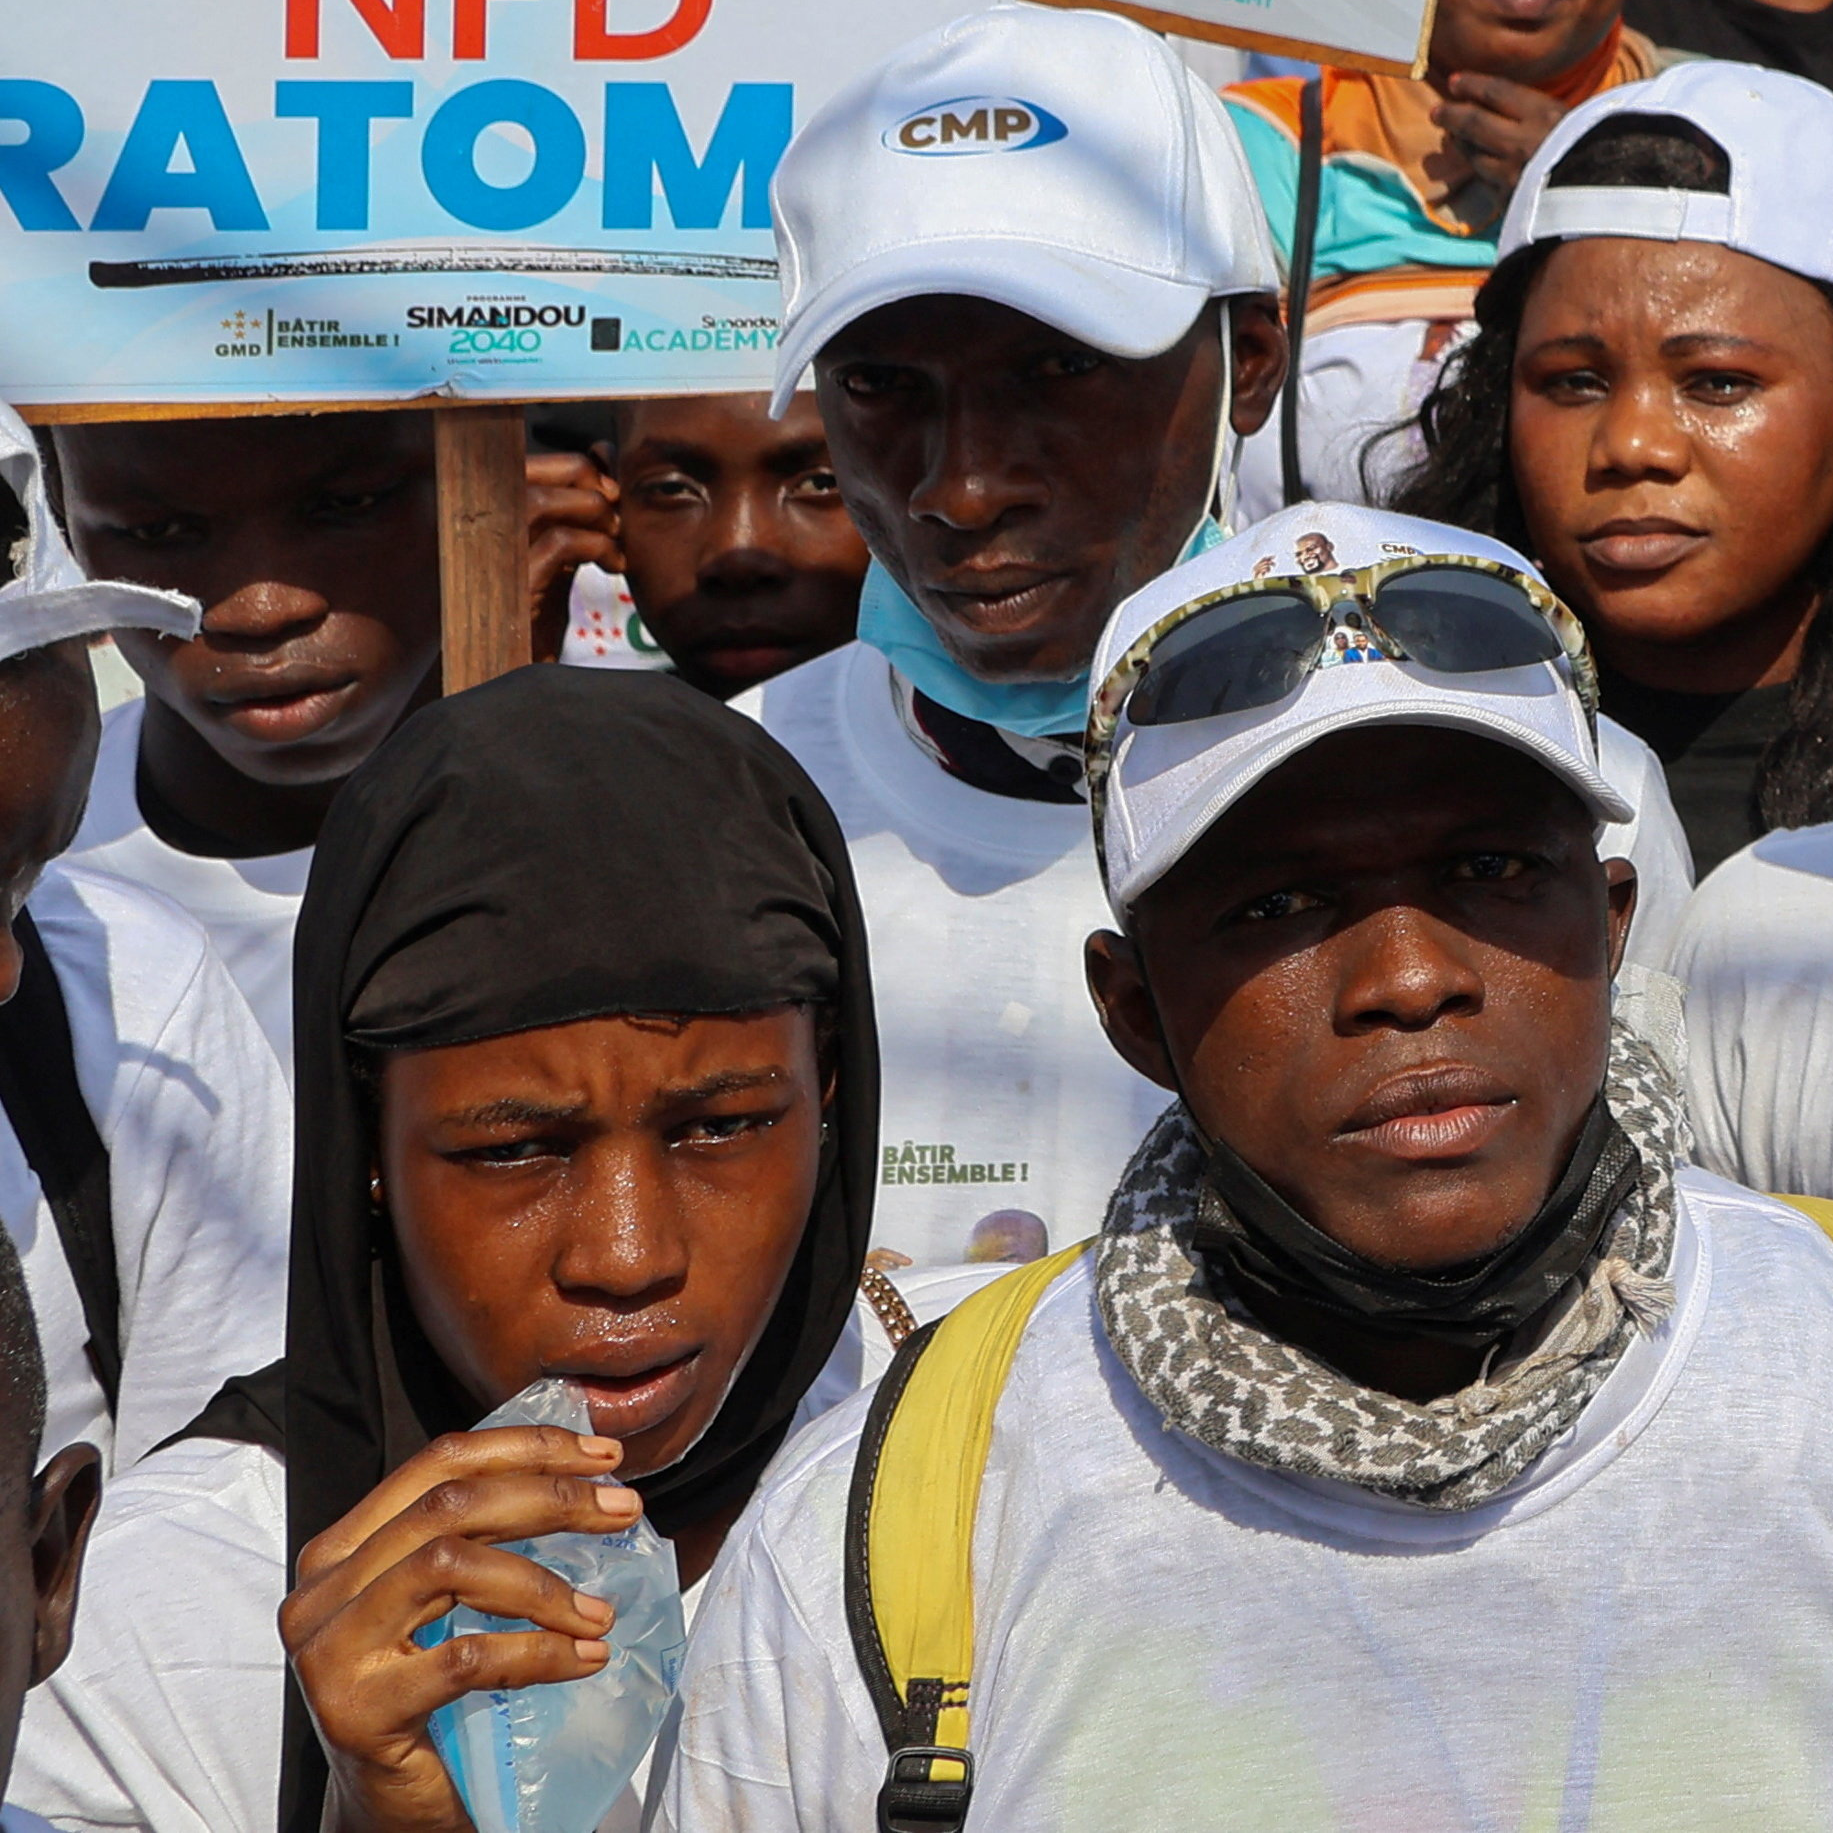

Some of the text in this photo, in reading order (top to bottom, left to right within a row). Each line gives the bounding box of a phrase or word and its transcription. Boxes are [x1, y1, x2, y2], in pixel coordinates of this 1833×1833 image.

[898, 107, 1032, 151] CMP
[278, 315, 341, 334] BÂTIR
[406, 304, 587, 331] SIMANDOU
[215, 343, 263, 358] GMD
[448, 327, 542, 354] 2040
[623, 326, 780, 354] ACADEMY
[882, 1139, 956, 1166] BÂTIR
